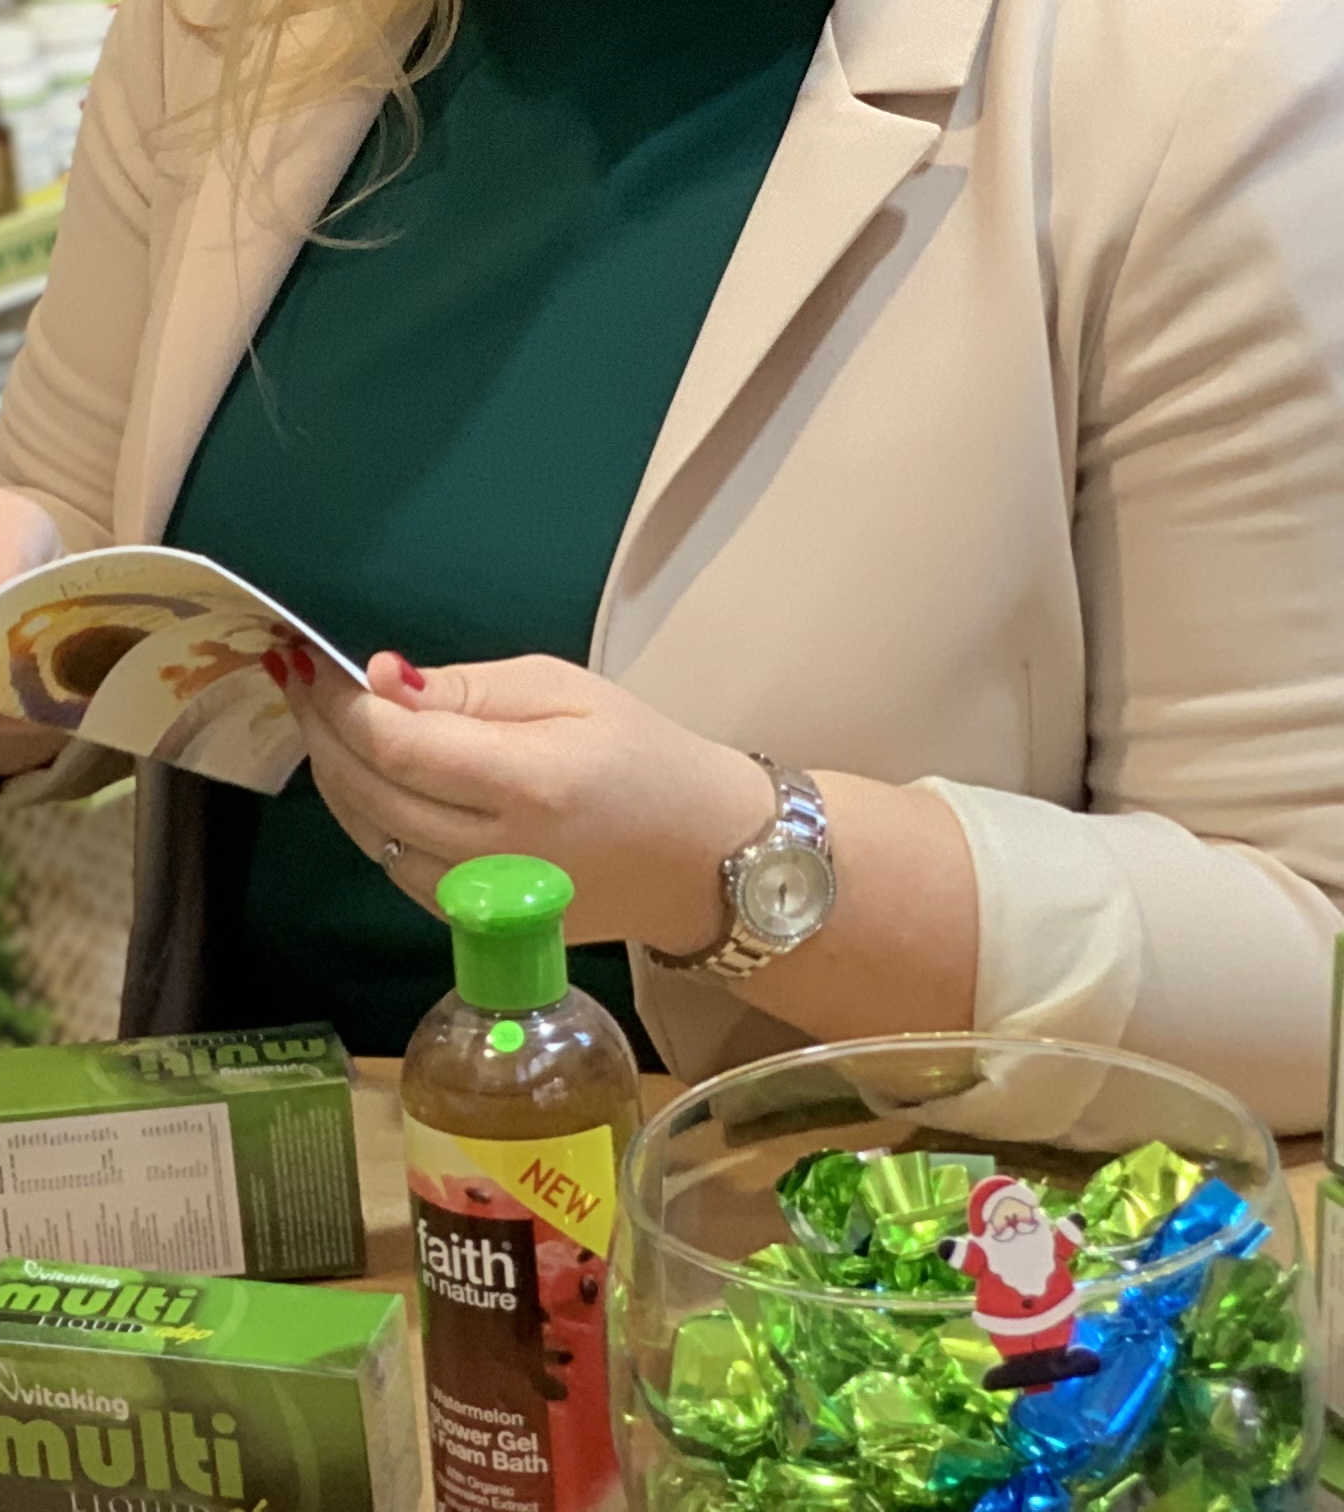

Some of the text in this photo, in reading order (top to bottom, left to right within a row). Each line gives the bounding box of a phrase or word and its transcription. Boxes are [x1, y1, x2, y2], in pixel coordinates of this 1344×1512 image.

[138, 1037, 328, 1081] multi
[517, 1157, 601, 1225] NEW
[416, 1218, 517, 1290] faith
[38, 1270, 120, 1290] vitaking
[438, 1278, 518, 1311] nature
[38, 1315, 146, 1334] LIQUID
[20, 1386, 130, 1422] vitaking
[430, 1382, 525, 1428] Watermelon
[429, 1402, 492, 1449] Shower
[496, 1430, 539, 1454] Gel
[438, 1430, 487, 1467] Foam
[492, 1450, 549, 1474] Bath
[466, 1474, 516, 1497] Organic
